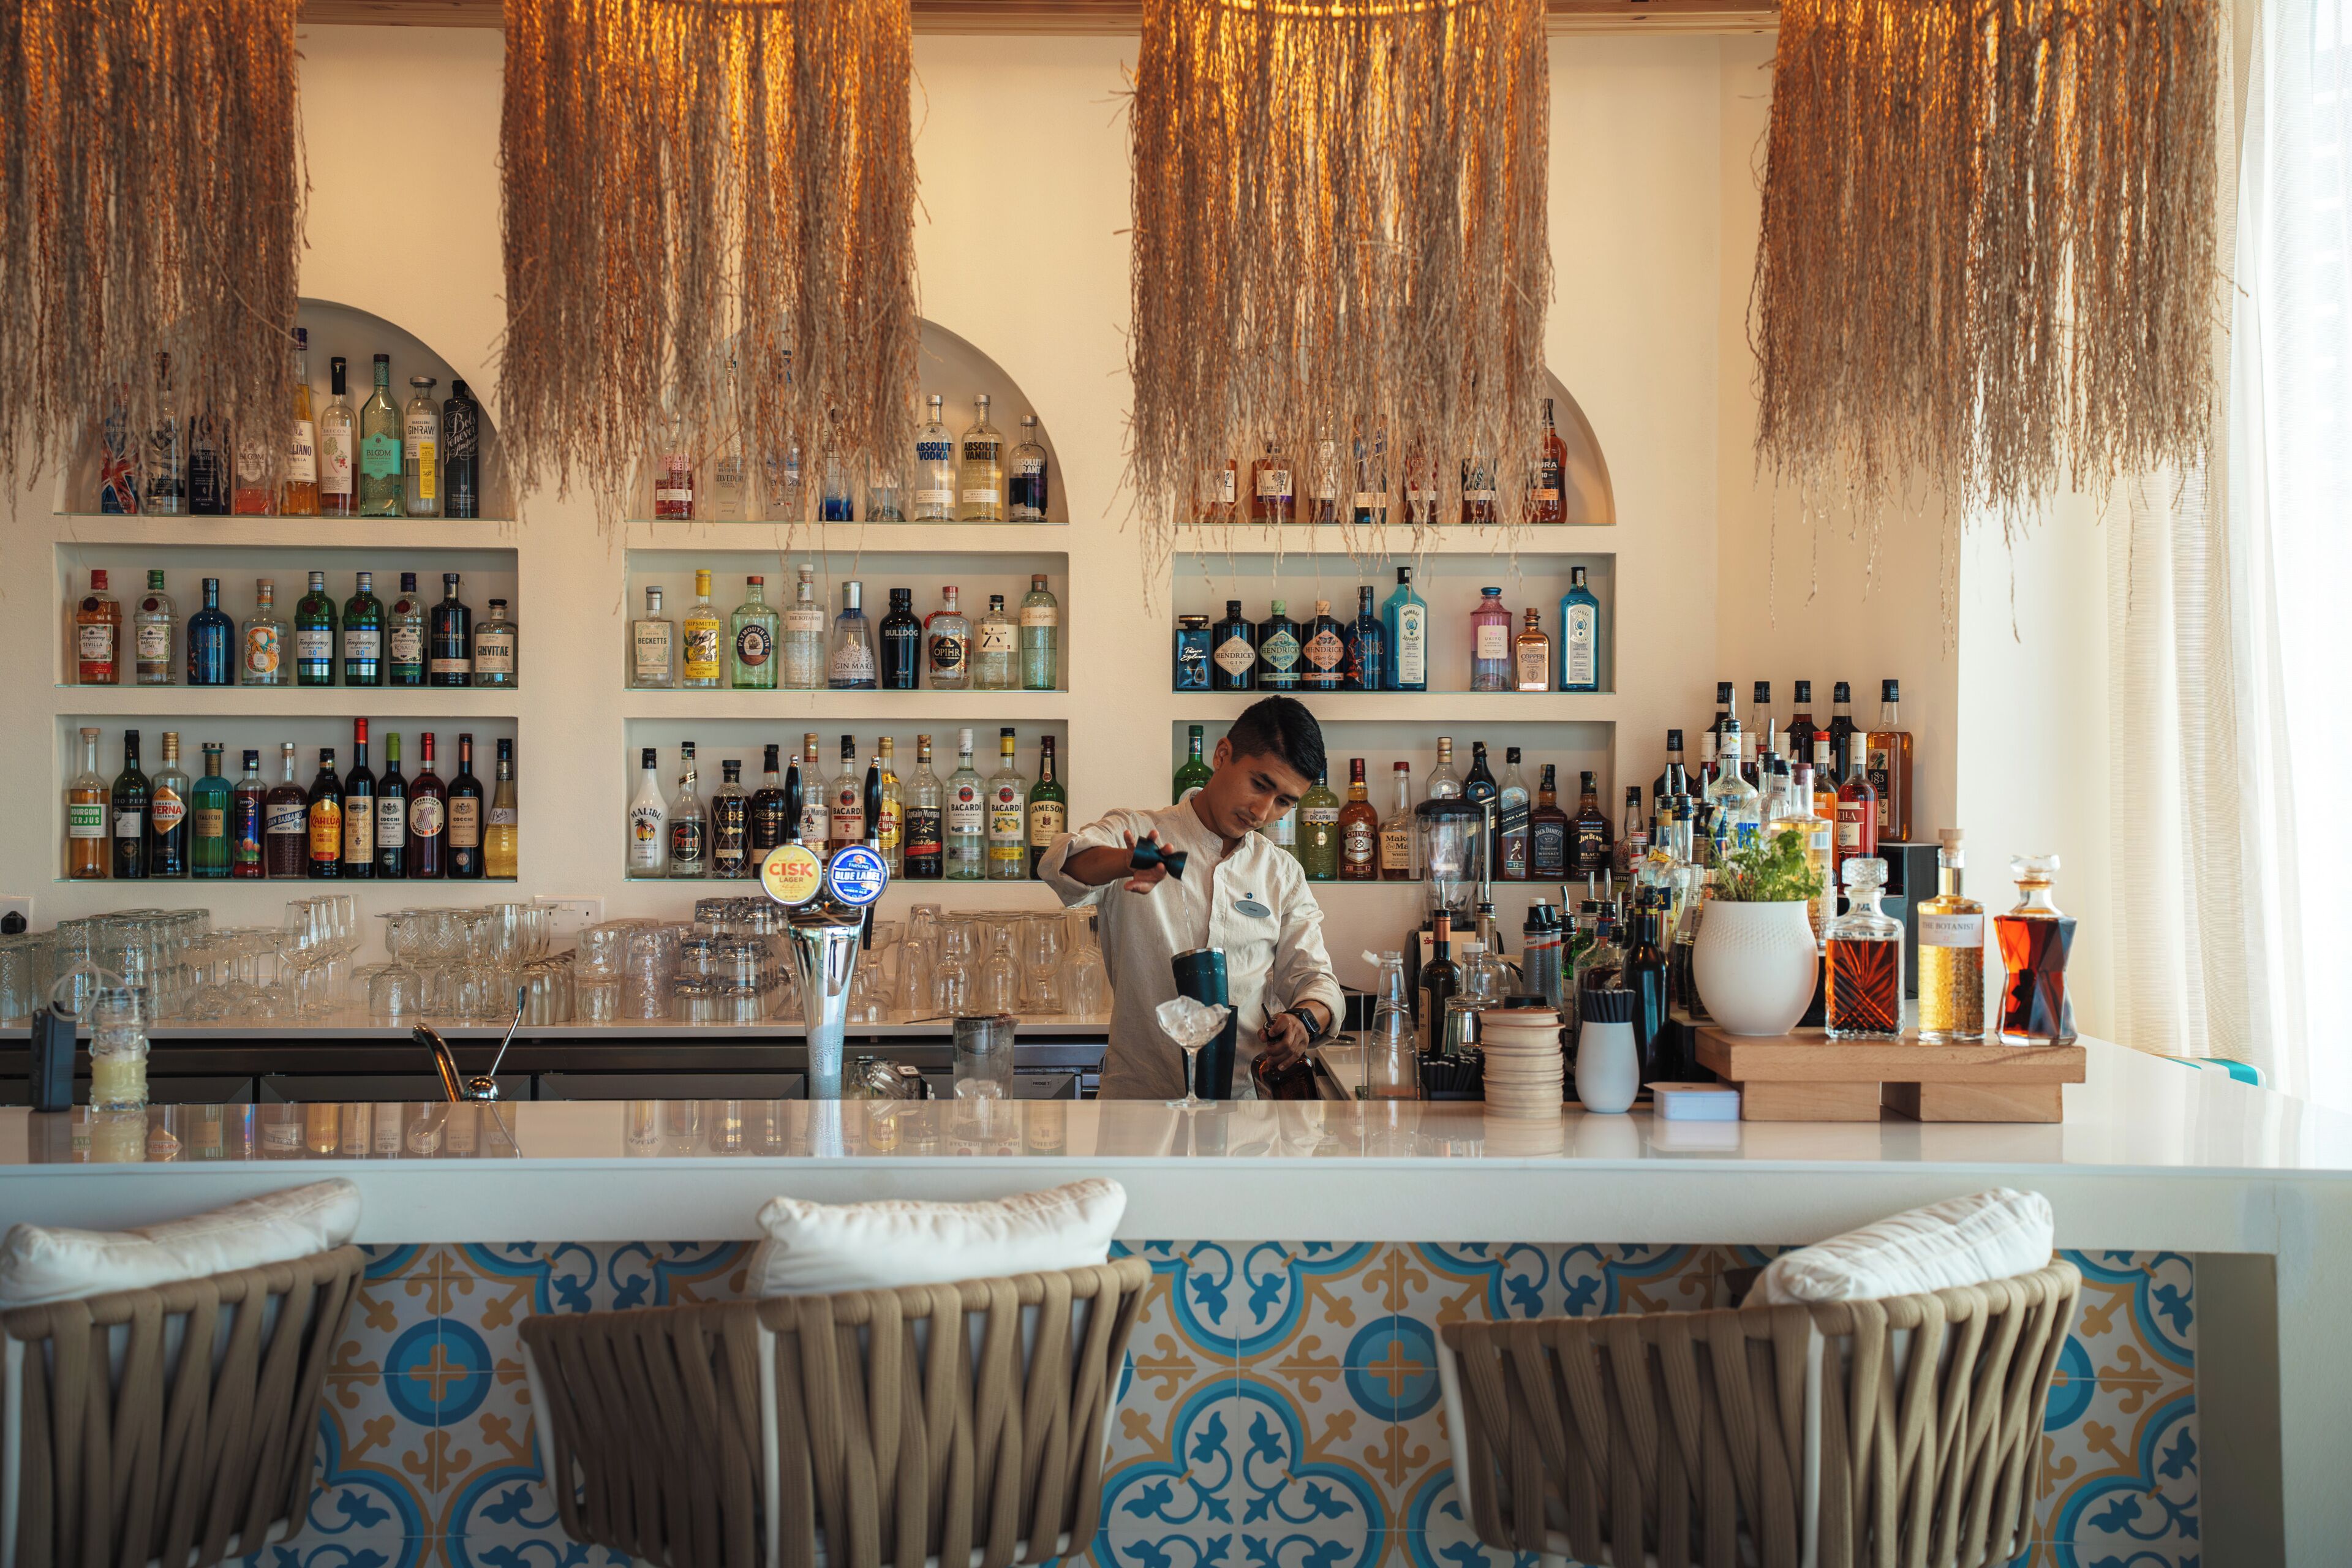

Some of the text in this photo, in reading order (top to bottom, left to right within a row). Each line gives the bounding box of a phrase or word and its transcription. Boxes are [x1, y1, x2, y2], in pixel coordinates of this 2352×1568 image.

[408, 426, 435, 435] GINRAW
[916, 442, 951, 451] ABSOLUT
[964, 442, 998, 451] ABSOLUT
[919, 451, 948, 460] VODKA
[965, 451, 997, 460] VANILIA
[738, 627, 764, 647] PLYMOUTH
[982, 627, 1006, 648] 六
[299, 639, 328, 647] Tanqueray
[347, 639, 376, 647] Tanqueray
[478, 646, 509, 656] GINVITAE
[934, 648, 961, 656] OPIHR
[152, 805, 182, 814] VERNA
[833, 806, 862, 815] BACARDÍ
[951, 802, 981, 811] BACARDÍ
[992, 803, 1022, 811] BACARDÍ
[1031, 804, 1063, 814] JAMESON
[490, 809, 508, 823] Bols
[631, 808, 662, 820] MALIBU
[754, 809, 786, 820] Zacapa
[811, 808, 827, 817] Morgan
[923, 809, 940, 819] Morgan
[310, 815, 340, 828] KAHLÚA
[1535, 827, 1563, 837] JACK DANIEL'S
[675, 835, 698, 848] PITÚ
[1579, 833, 1603, 843] JIM BEAM
[769, 863, 813, 877] CISK
[835, 871, 880, 881] BLUE LABEL
[1922, 922, 1974, 931] THE BOTANIST
